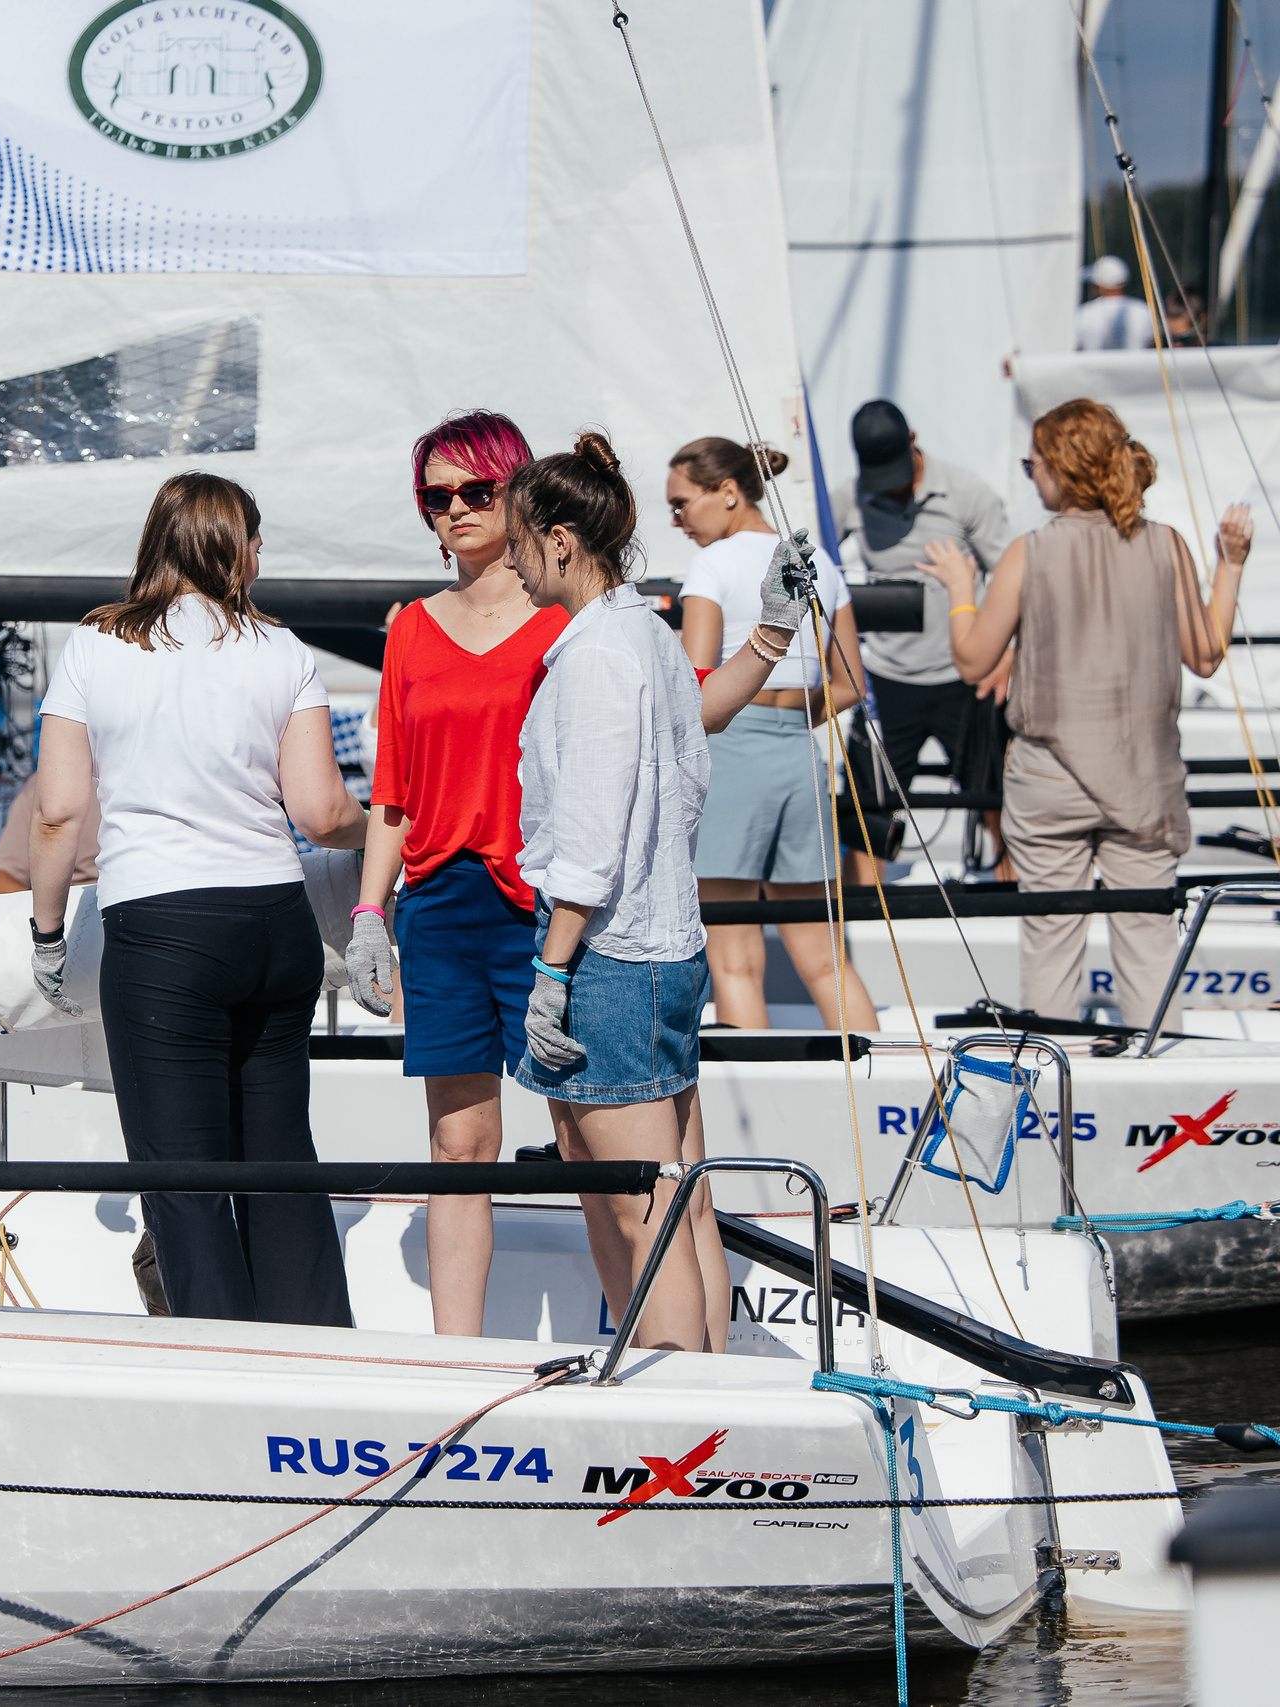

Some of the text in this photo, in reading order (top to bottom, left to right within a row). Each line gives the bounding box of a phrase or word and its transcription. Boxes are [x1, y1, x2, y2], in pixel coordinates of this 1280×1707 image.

[98, 6, 292, 55] GOLF & YACHT CLUB
[140, 110, 243, 130] PESTOVO
[1184, 971, 1271, 994] 7276
[878, 1105, 1097, 1141] RU 275
[267, 1436, 554, 1483] RUS 7274
[696, 1470, 755, 1479] SAILING
[760, 1473, 812, 1482] BOATS
[752, 1519, 849, 1530] CARBON
